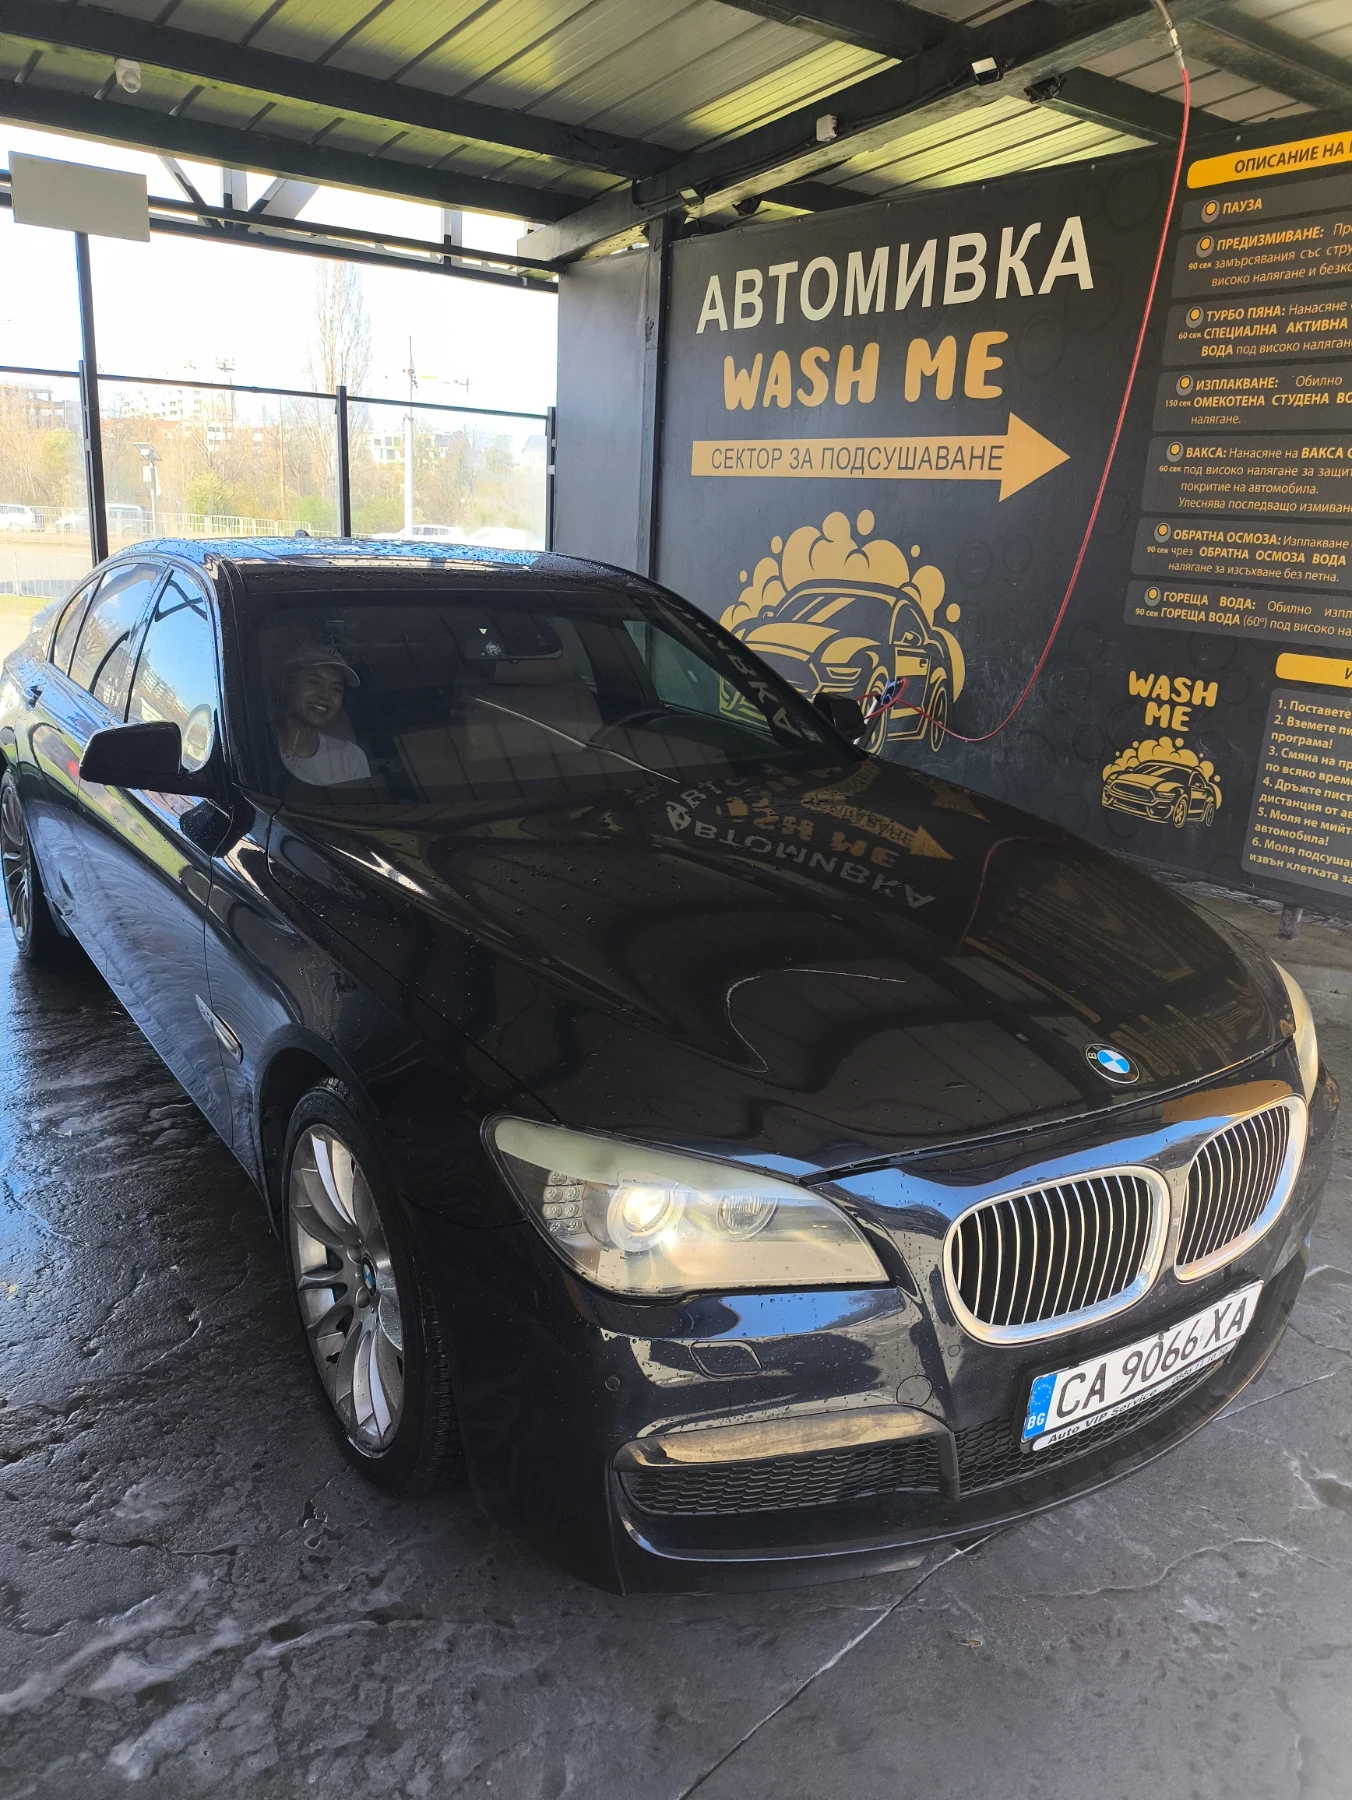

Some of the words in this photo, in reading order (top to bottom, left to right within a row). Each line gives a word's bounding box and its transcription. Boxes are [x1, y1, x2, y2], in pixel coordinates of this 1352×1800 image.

[1234, 145, 1318, 174] ОПИСАНИЕ
[1323, 142, 1344, 157] НА
[1222, 198, 1262, 215] ПАУЗА
[1217, 226, 1325, 251] ПРЕДИЗМИВАНЕ:
[1188, 262, 1197, 270] 90
[1214, 251, 1296, 269] замърсявания
[1300, 248, 1321, 260] със
[696, 215, 1094, 334] АВТОМИВКА
[1211, 274, 1250, 287] високо
[1253, 267, 1306, 286] налягане
[1309, 266, 1316, 276] и
[1207, 309, 1245, 322] ТУРБО
[1248, 307, 1286, 319] ПЯНА:
[1289, 303, 1347, 316] Нанасяне
[1178, 332, 1187, 340] 60
[1204, 324, 1277, 340] СПЕЦИАЛНА
[1286, 319, 1347, 334] АКТИВНА
[1201, 345, 1233, 358] ВОДА
[1236, 345, 1256, 356] под
[1259, 342, 1300, 353] високо
[723, 342, 880, 411] WASH
[904, 331, 1009, 403] ME
[1196, 377, 1278, 391] ИЗПЛАКВАНЕ:
[1296, 376, 1342, 387] Обилно
[1165, 399, 1177, 407] 150
[1194, 396, 1265, 407] ОМЕКОТЕНА
[1272, 394, 1329, 407] СТУДЕНА
[1191, 414, 1241, 427] налягане.
[711, 448, 783, 470] СЕКТОР
[789, 447, 813, 470] ЗА
[821, 445, 1005, 475] ПОДСУШАВАНЕ
[1186, 447, 1226, 458] ВАКСА:
[1229, 448, 1281, 458] Нанасяне
[1285, 450, 1298, 458] на
[1301, 448, 1343, 458] ВАКСА
[1183, 466, 1202, 476] под
[1206, 466, 1243, 475] високо
[1247, 466, 1298, 478] налягане
[1302, 468, 1314, 476] за
[1181, 483, 1231, 492] покритие
[1233, 483, 1245, 492] на
[1248, 482, 1319, 494] автомобила.
[1178, 497, 1225, 509] Улеснява
[1228, 501, 1297, 512] последващо
[1173, 529, 1224, 542] ОБРАТНА
[1227, 532, 1281, 545] ОСМОЗА:
[1283, 535, 1349, 549] Изплакване
[1172, 547, 1193, 557] чрез
[1200, 547, 1249, 559] ОБРАТНА
[1256, 550, 1305, 563] ОСМОЗА
[1312, 553, 1346, 566] ВОДА
[1168, 562, 1213, 574] налягане
[1215, 565, 1225, 574] за
[1228, 566, 1282, 578] изсъхване
[1284, 568, 1302, 579] без
[1305, 570, 1339, 582] петна.
[1163, 592, 1208, 606] ГОРЕЩА
[1220, 596, 1256, 610] ВОДА:
[1268, 601, 1312, 615] Обилно
[1135, 608, 1144, 616] 90
[1146, 609, 1158, 617] сек
[1161, 608, 1205, 623] ГОРЕЩА
[1209, 611, 1240, 625] ВОДА
[1270, 620, 1290, 632] под
[1293, 623, 1334, 635] високо
[1338, 626, 1352, 637] на
[1129, 671, 1218, 707] WASH
[1145, 701, 1192, 731] ME
[1278, 699, 1287, 710] 1.
[1289, 700, 1351, 719] Поставете
[1274, 715, 1284, 725] 2.
[1287, 717, 1336, 733] Вземете
[1271, 731, 1333, 749] програма!
[1269, 746, 1278, 756] 3.
[1281, 749, 1318, 764] Смяна
[1321, 756, 1336, 766] на
[1266, 763, 1279, 773] по
[1282, 766, 1316, 780] всяко
[1263, 777, 1273, 787] 4.
[1275, 780, 1321, 797] Дръжте
[1259, 794, 1321, 811] дистанция
[1325, 805, 1338, 815] от
[1258, 808, 1267, 818] 5.
[1270, 810, 1301, 825] Моля
[1304, 818, 1317, 828] не
[1255, 823, 1329, 846] автомобила!
[1252, 838, 1261, 848] 6.
[1264, 840, 1295, 856] Моля
[1249, 853, 1283, 868] извън
[1286, 860, 1339, 881] клетката
[1121, 1319, 1200, 1394] 9066
[1027, 1412, 1046, 1429] BG
[1048, 1425, 1080, 1444] Auto
[1085, 1411, 1109, 1428] VIP
[1113, 1389, 1157, 1415] Service
